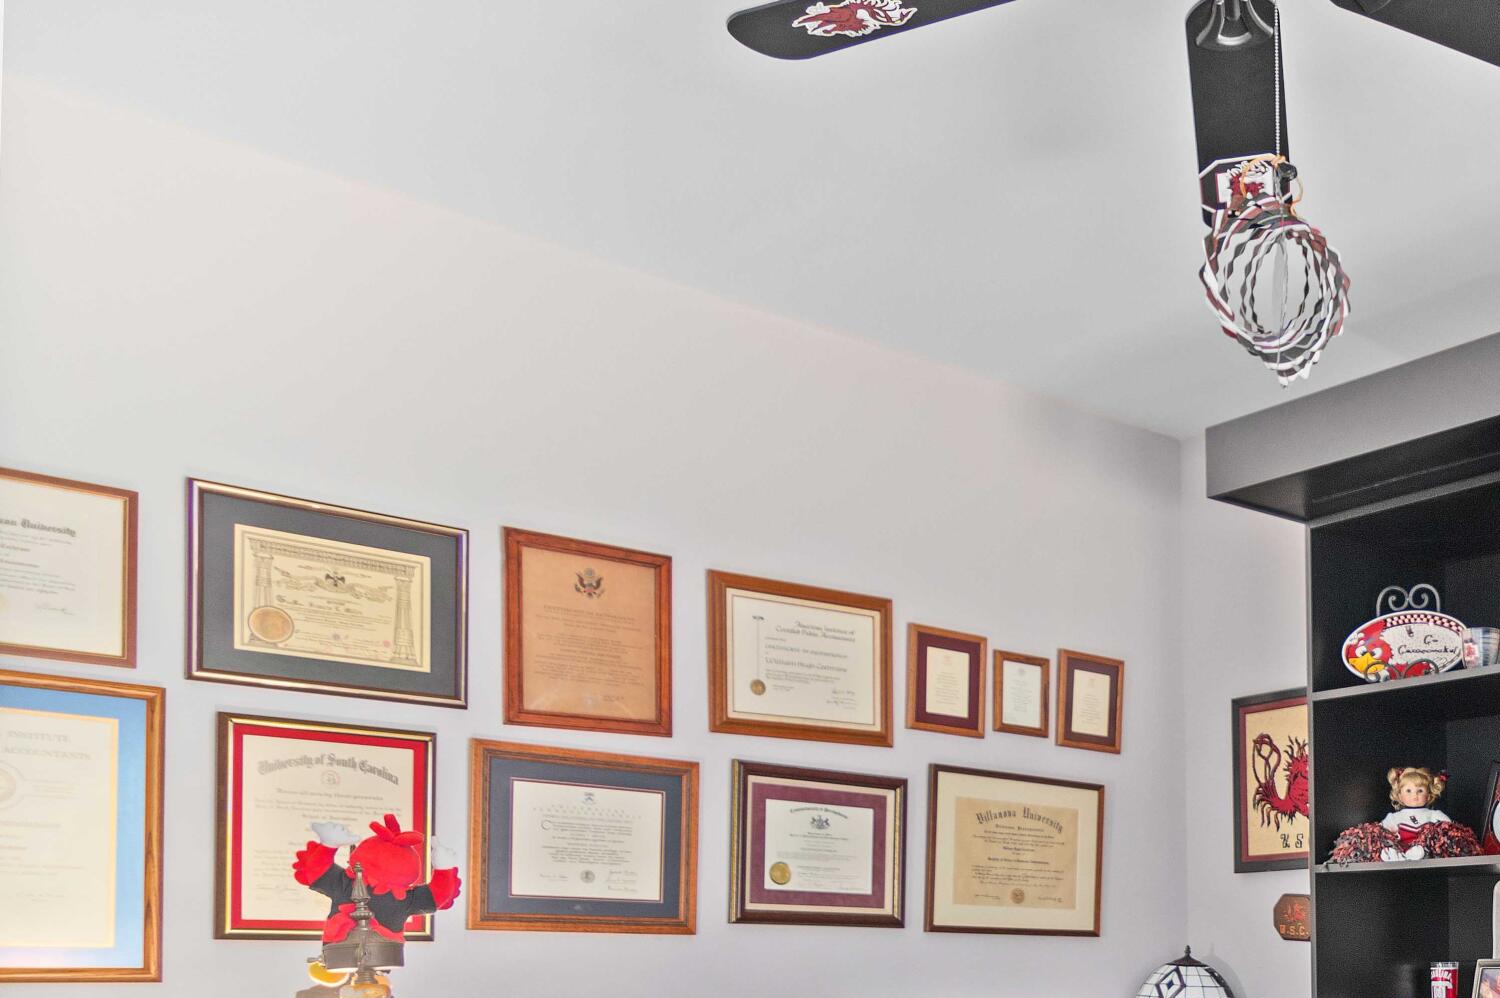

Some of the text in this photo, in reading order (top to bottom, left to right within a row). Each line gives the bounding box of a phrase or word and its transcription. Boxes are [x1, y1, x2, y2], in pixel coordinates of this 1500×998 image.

[258, 752, 400, 786] University of South Carolina
[975, 806, 1063, 834] Villanova University
[1294, 833, 1304, 849] S
